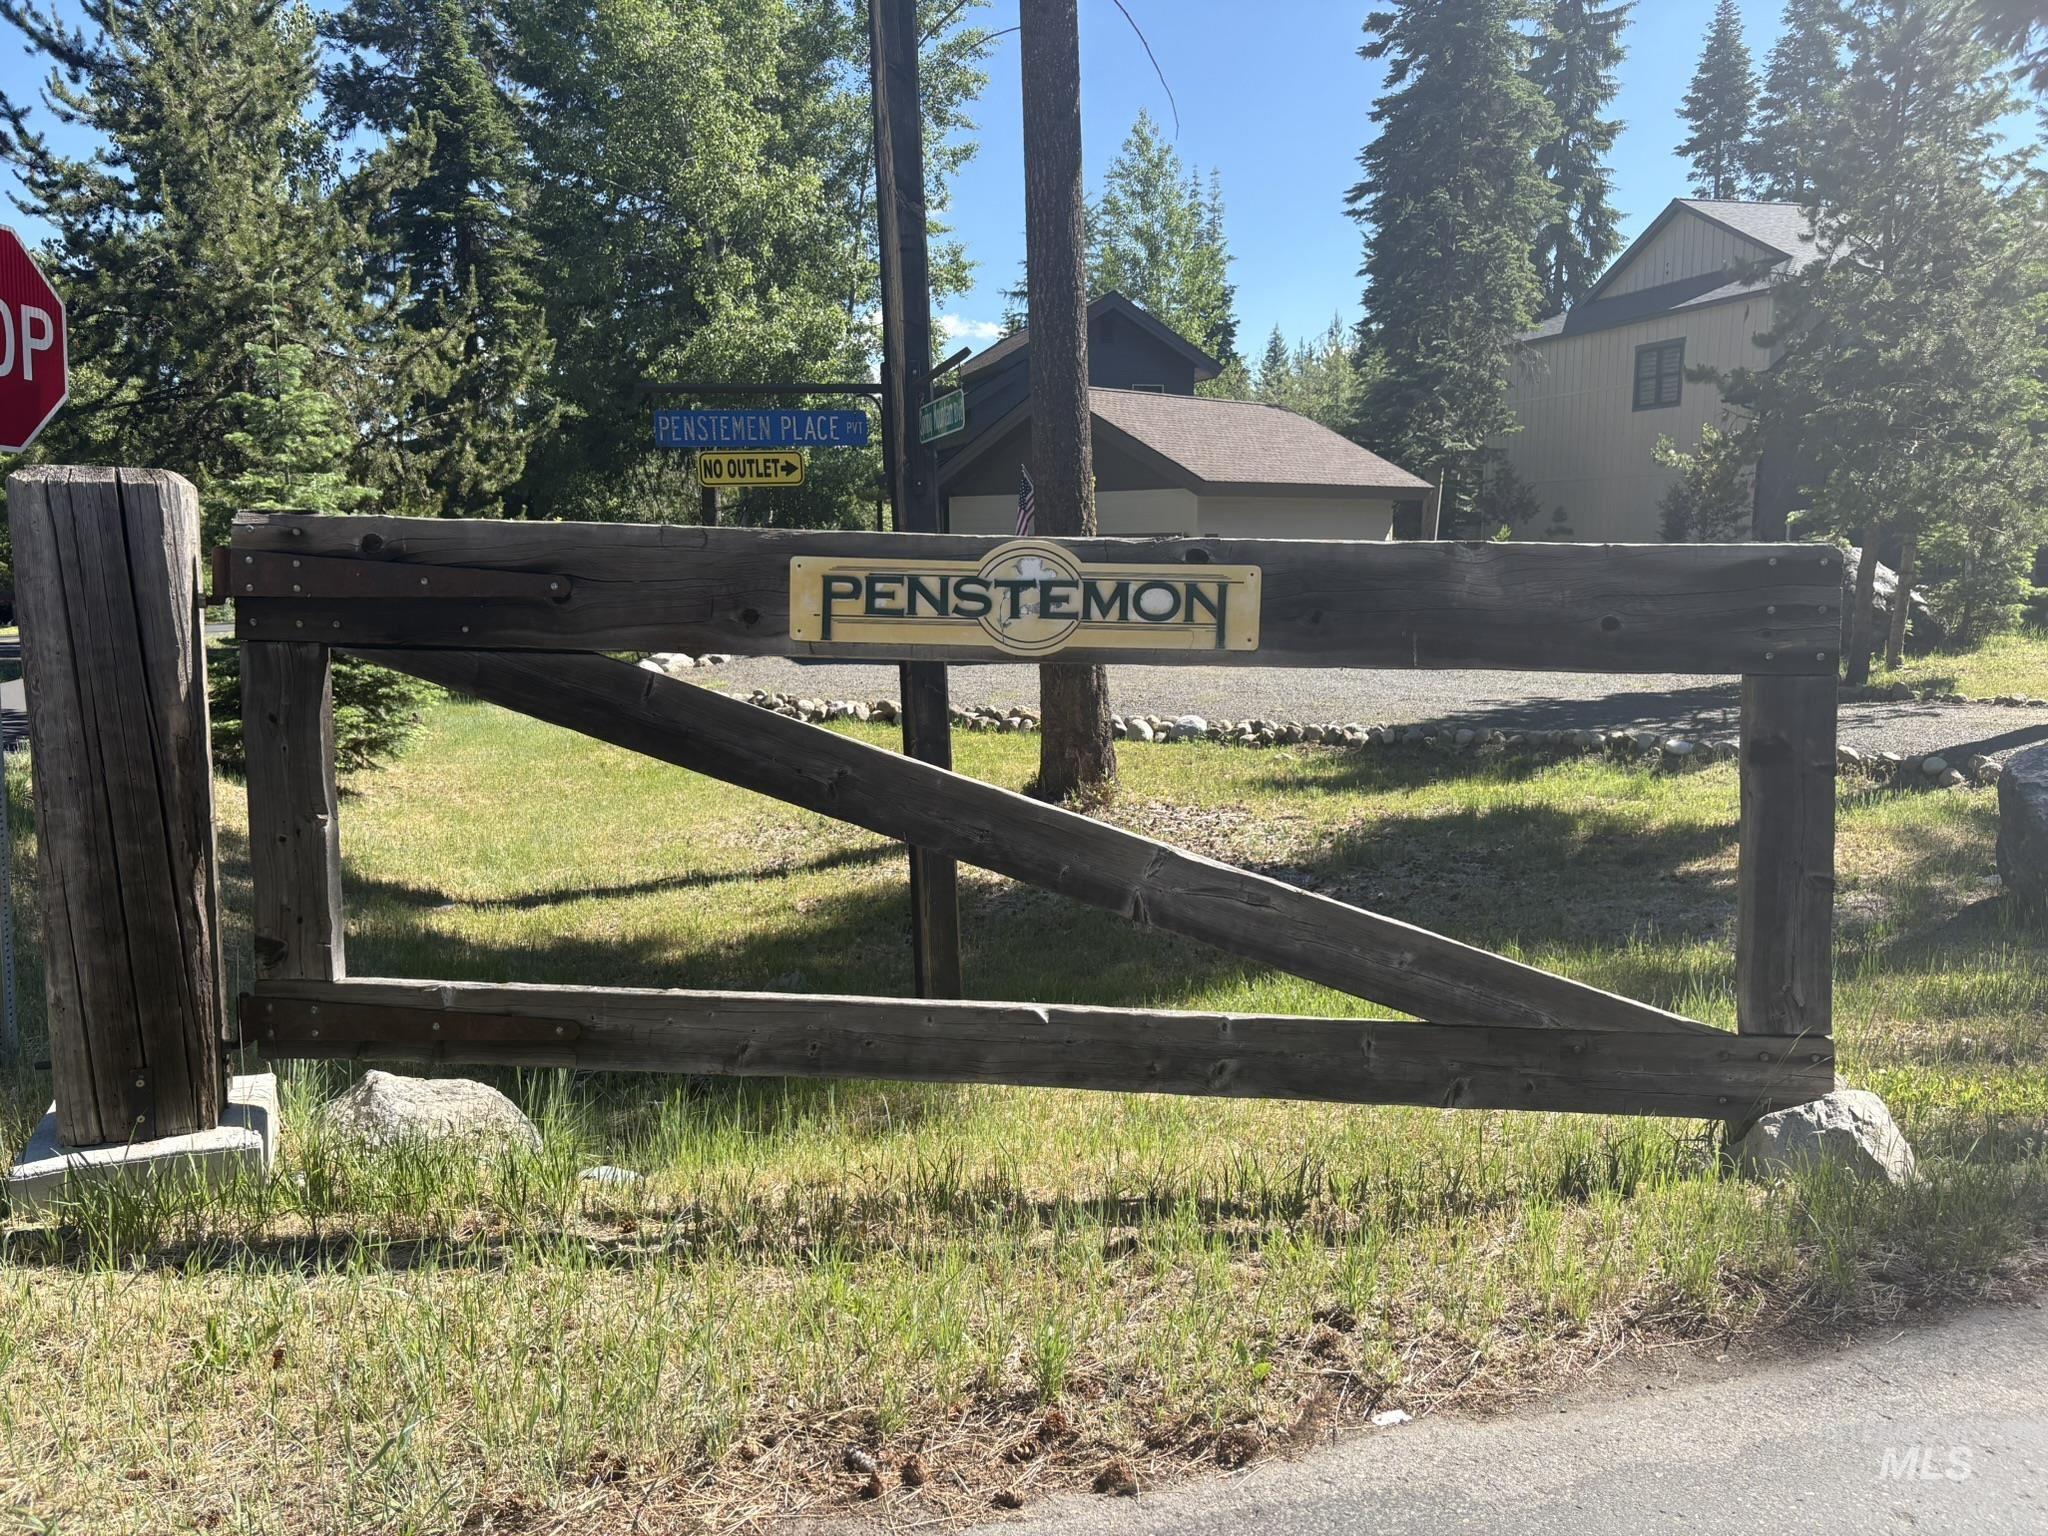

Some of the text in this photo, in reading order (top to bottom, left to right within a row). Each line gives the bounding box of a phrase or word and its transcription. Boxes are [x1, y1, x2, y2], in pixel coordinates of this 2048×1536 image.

[658, 415, 863, 441] PENSTEMEN PLACE PVT
[703, 458, 780, 479] NO OUTLET
[821, 574, 1228, 649] PENSTEMON
